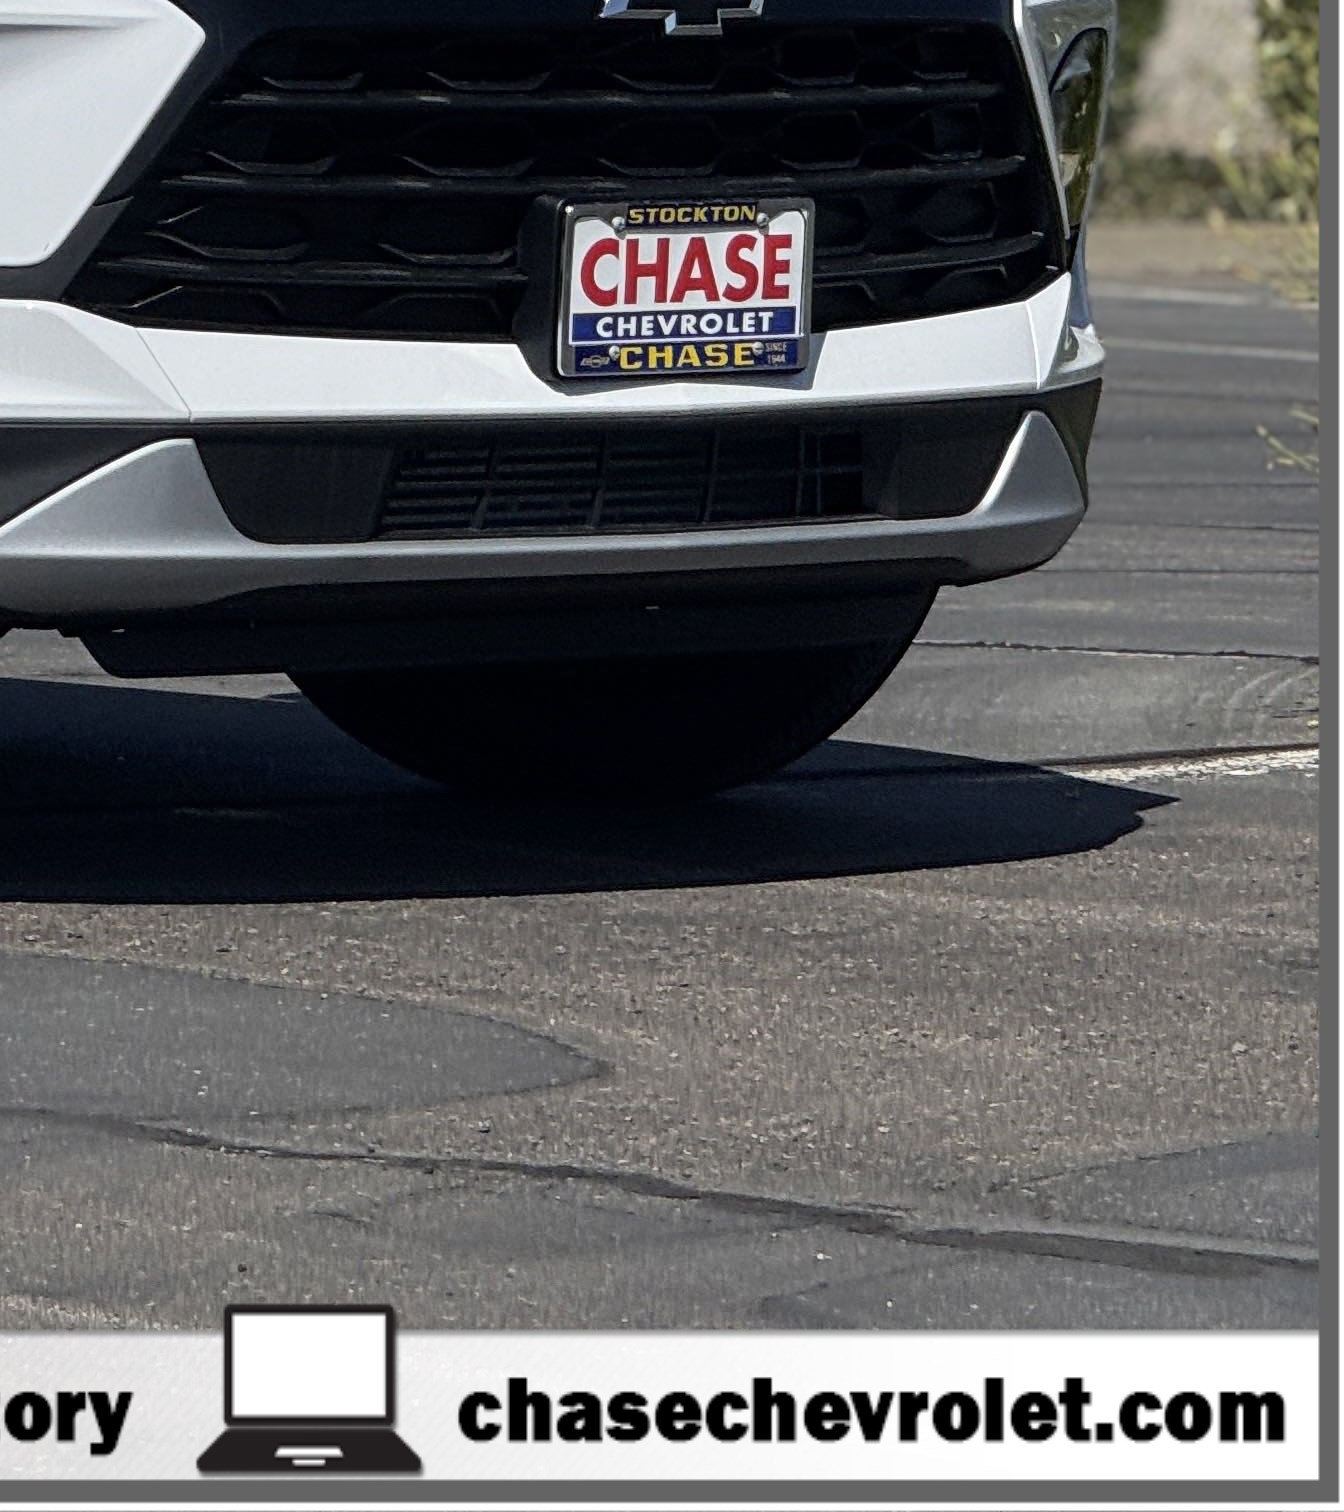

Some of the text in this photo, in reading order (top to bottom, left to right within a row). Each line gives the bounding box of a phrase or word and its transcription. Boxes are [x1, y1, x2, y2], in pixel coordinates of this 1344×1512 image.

[627, 204, 756, 224] STOCKTON
[579, 233, 793, 307] CHASE
[595, 311, 774, 338] CHEVROLET
[619, 342, 755, 369] CHASE
